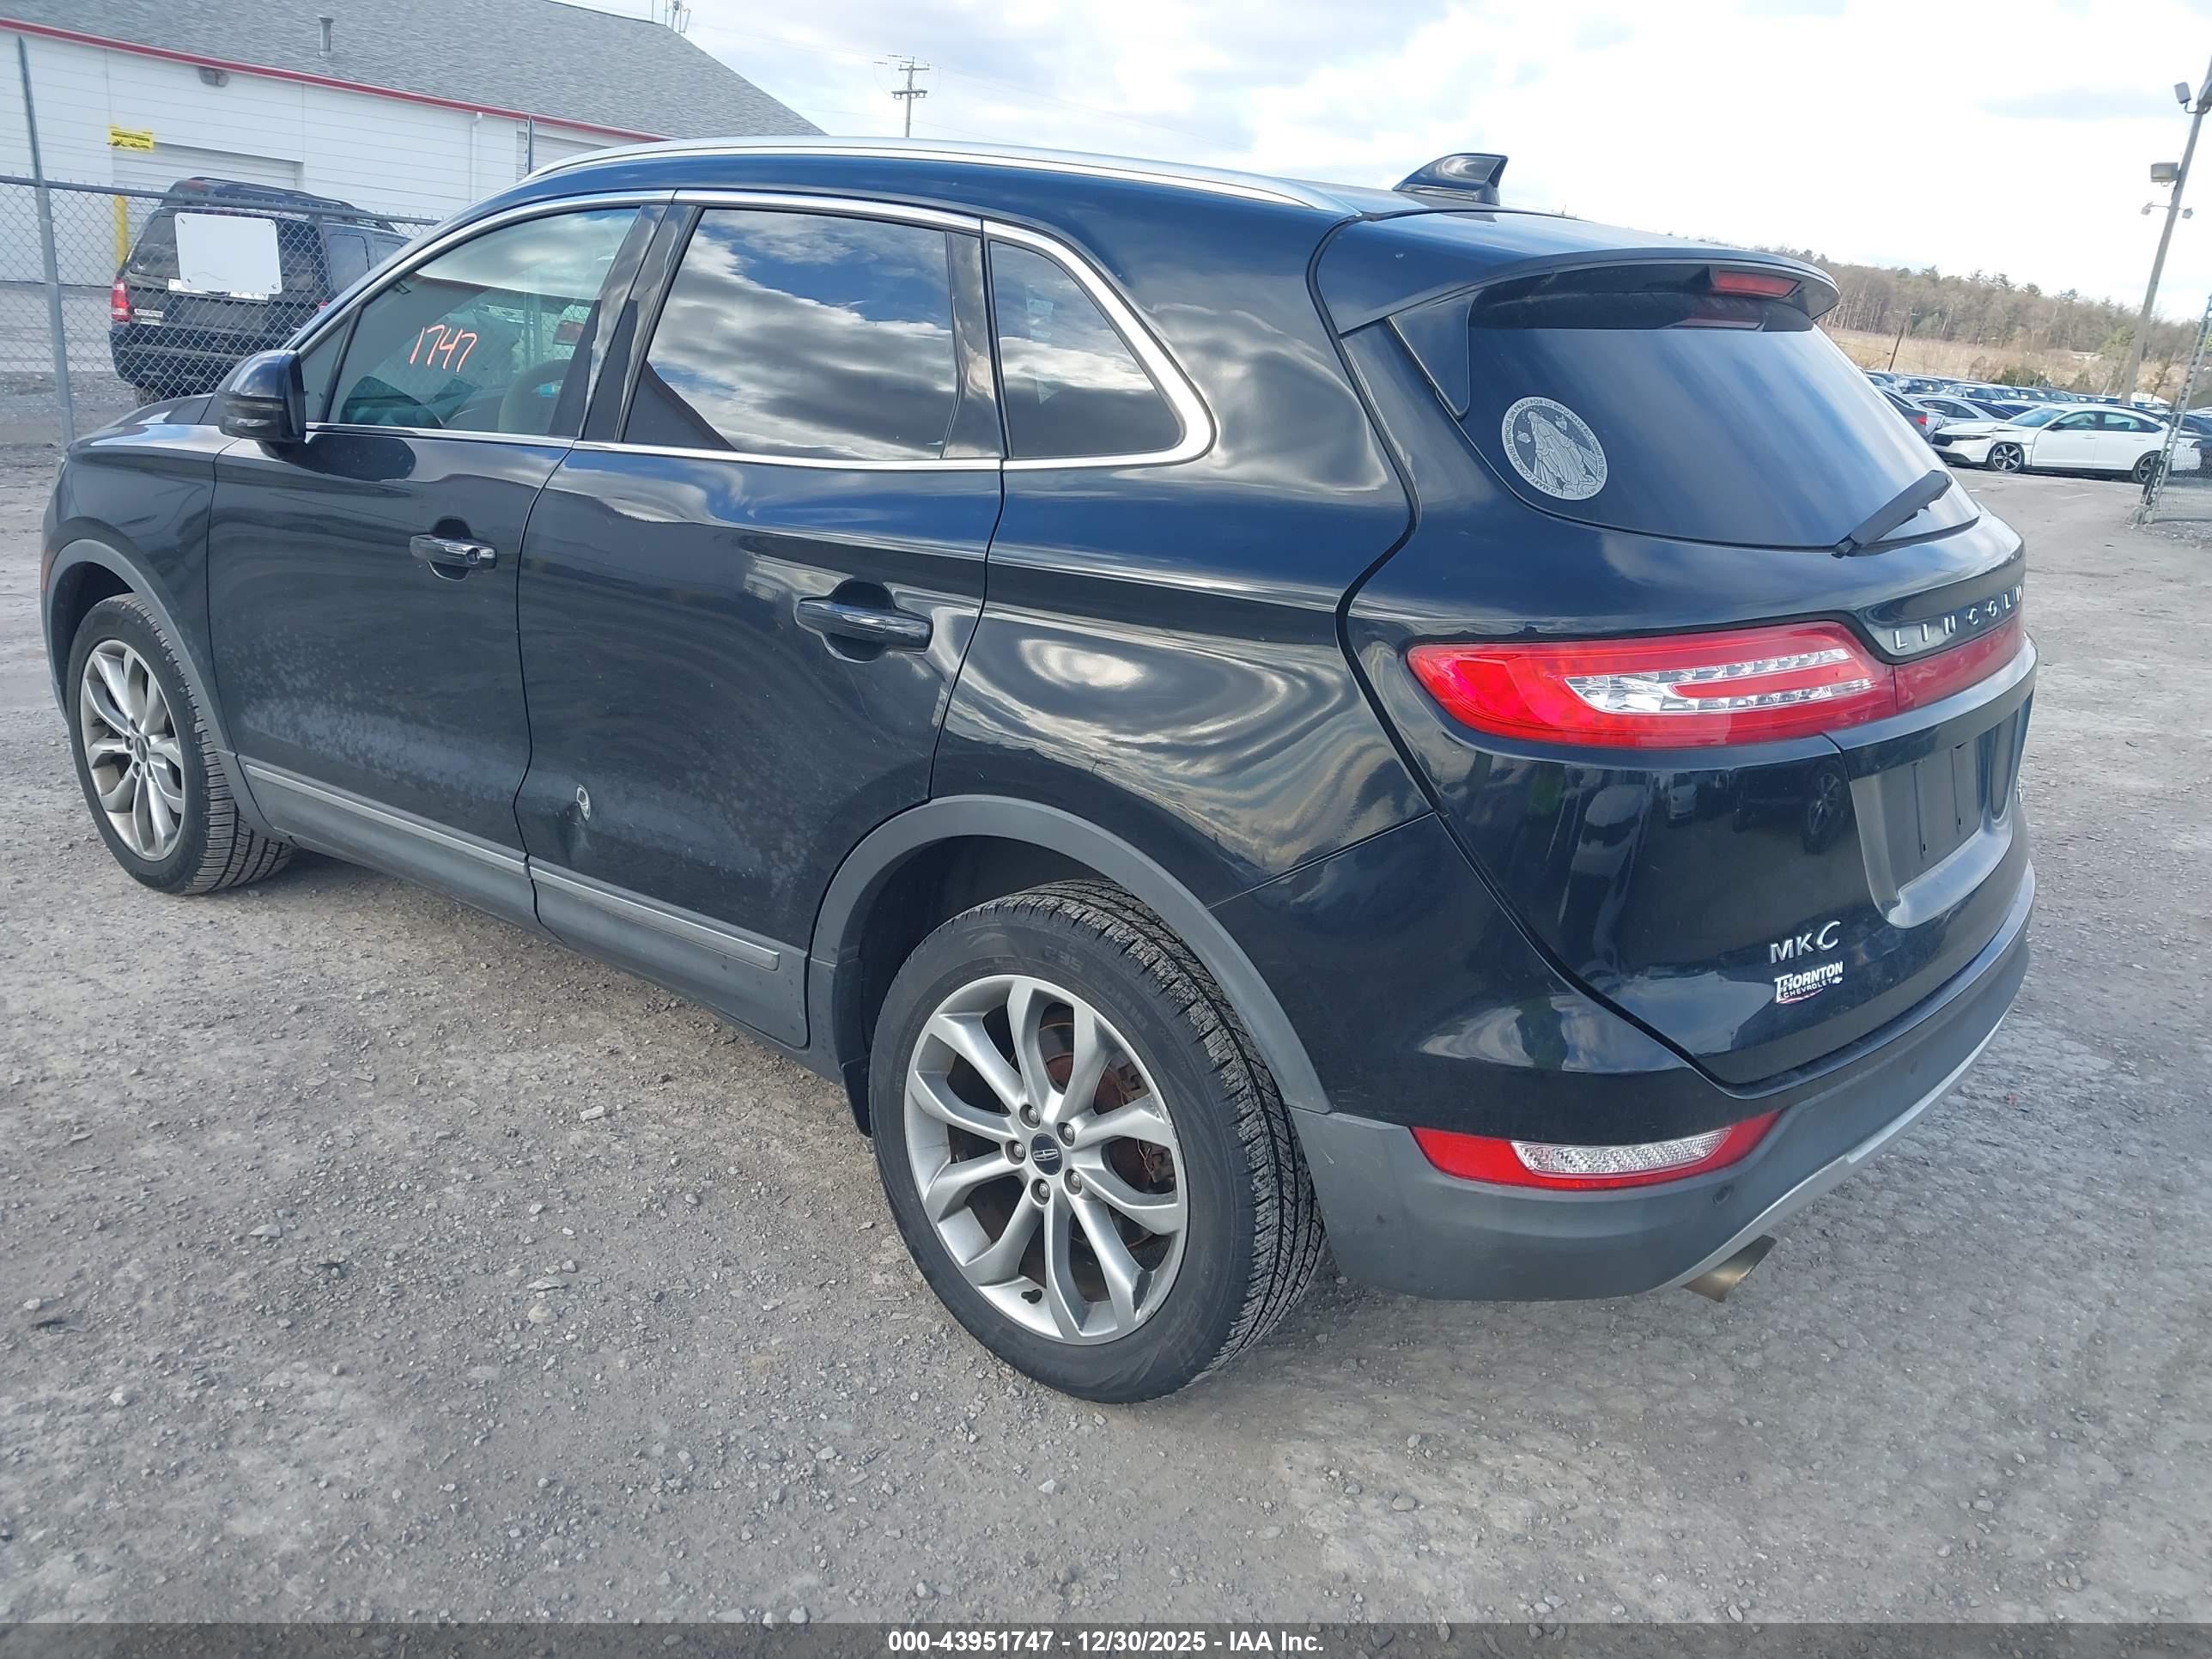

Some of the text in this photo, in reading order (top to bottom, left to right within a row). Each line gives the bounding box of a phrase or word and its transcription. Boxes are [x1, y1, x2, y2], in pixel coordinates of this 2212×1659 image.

[410, 325, 477, 373] 1747
[1514, 401, 1528, 411] PRAY
[1508, 447, 1532, 478] CONCEIVED
[1531, 477, 1551, 491] MARY
[1893, 584, 2023, 649] LINCOLN
[1769, 921, 1841, 964] MKC
[1774, 961, 1844, 1003] THORNTON
[1784, 979, 1832, 998] CHEVROLET
